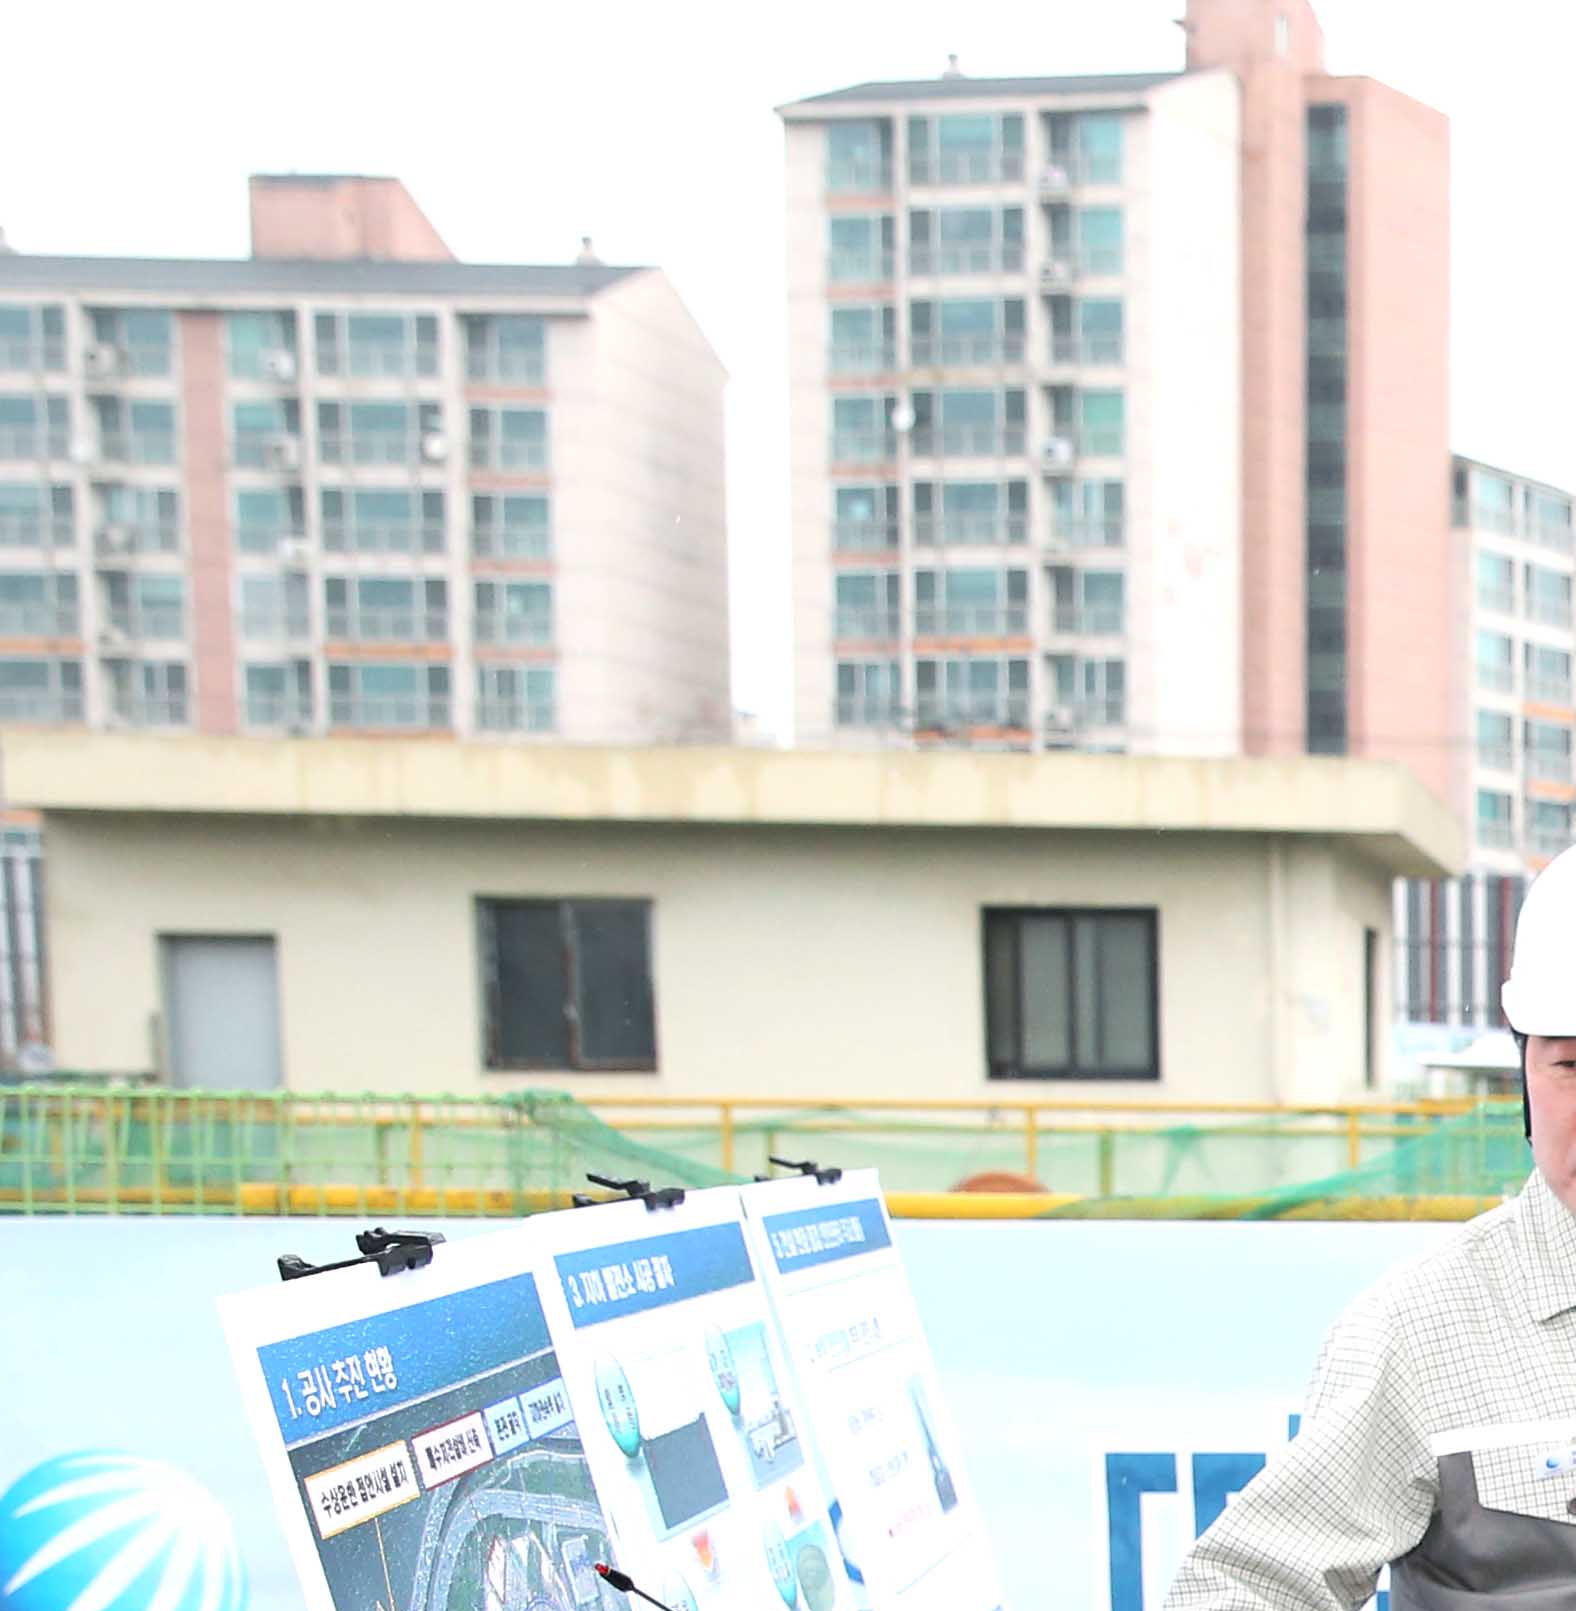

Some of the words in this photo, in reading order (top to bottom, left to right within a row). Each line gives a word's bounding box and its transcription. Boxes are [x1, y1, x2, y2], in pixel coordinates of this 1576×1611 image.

[281, 1378, 302, 1419] 1.
[297, 1365, 336, 1415] 공사
[331, 1355, 368, 1402] 추진
[363, 1346, 397, 1392] 현황
[389, 1460, 408, 1488] 설치
